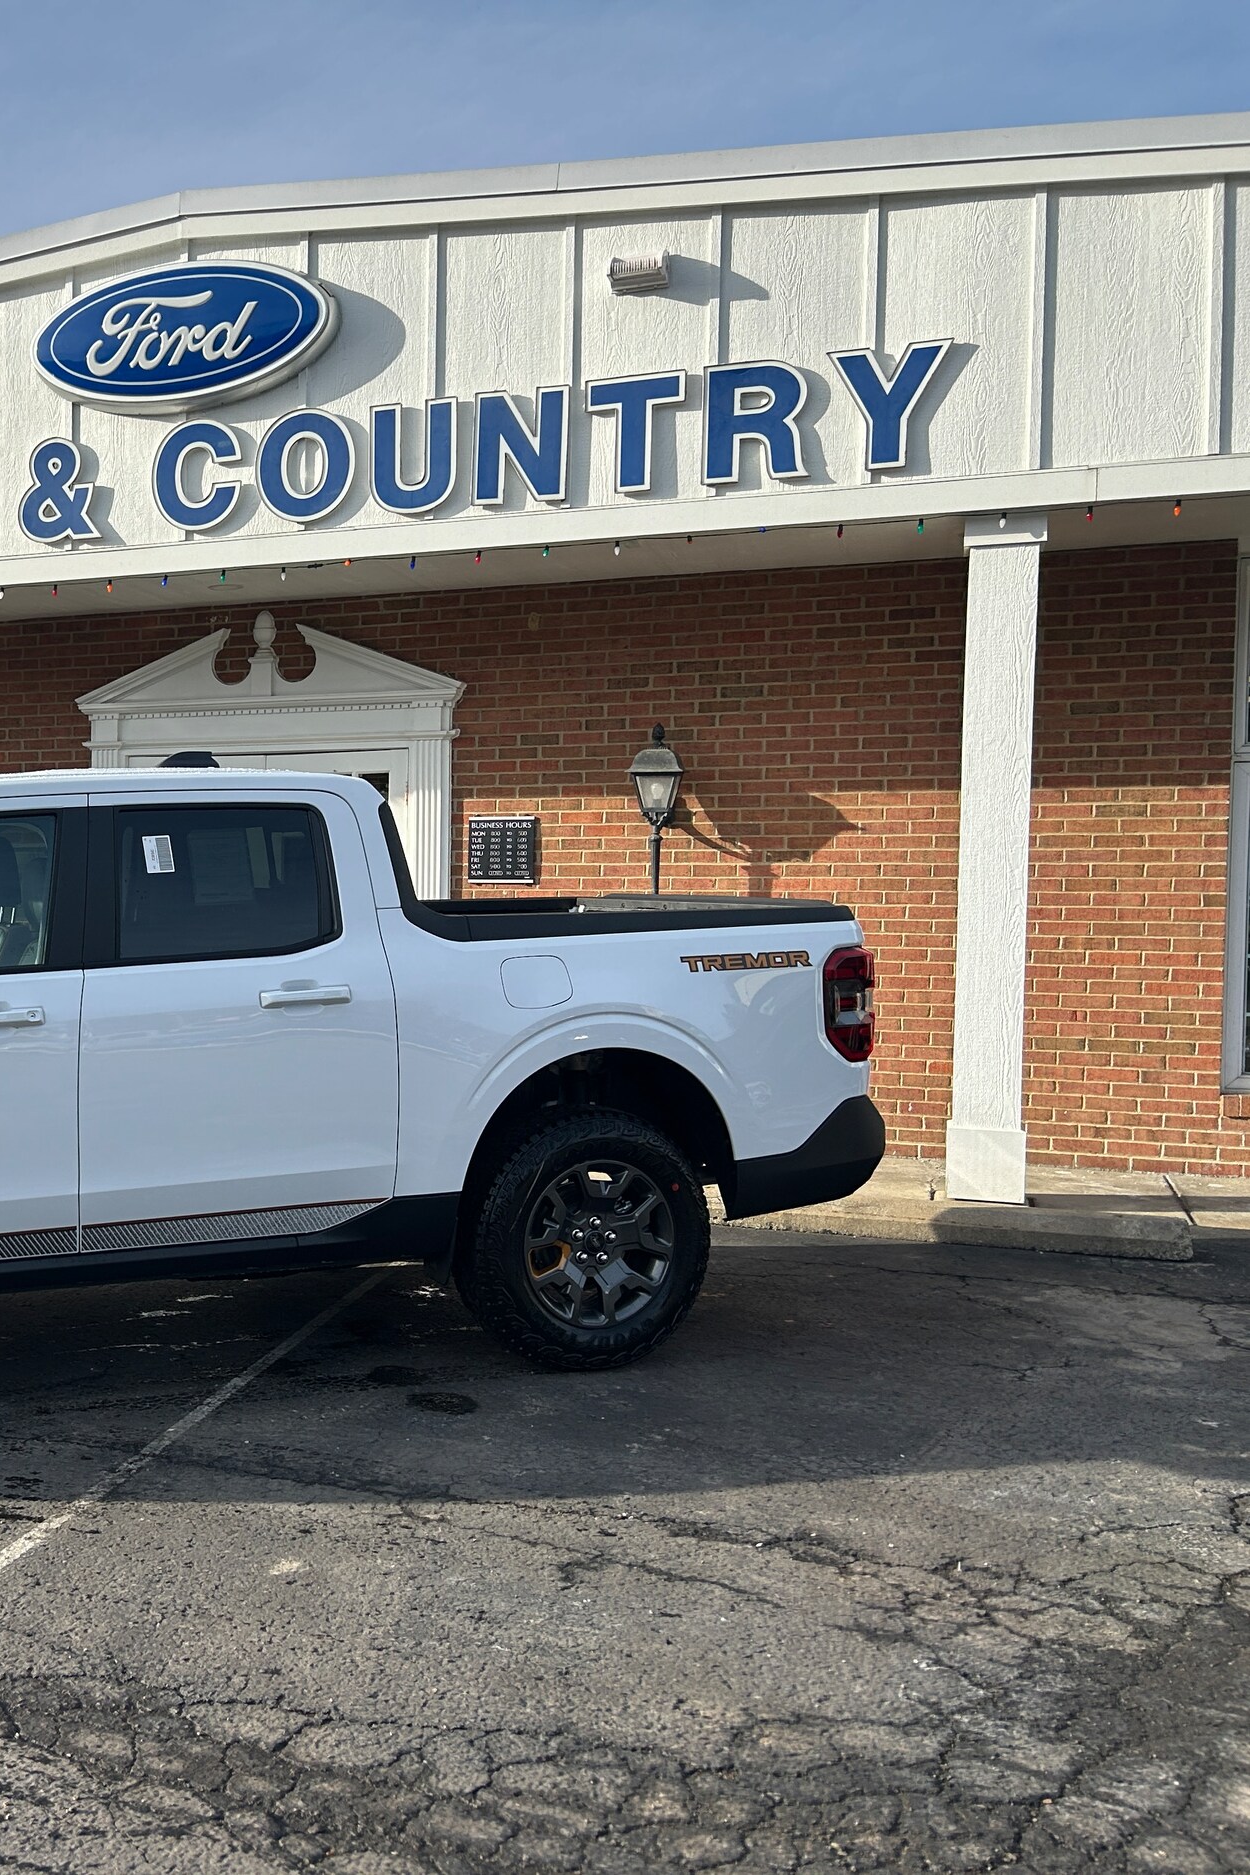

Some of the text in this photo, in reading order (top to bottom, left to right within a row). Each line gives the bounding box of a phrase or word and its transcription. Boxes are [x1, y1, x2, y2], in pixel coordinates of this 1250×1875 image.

[86, 290, 259, 376] Ford
[18, 436, 104, 544] &
[152, 337, 955, 532] COUNTRY
[680, 951, 813, 972] TREMOR
